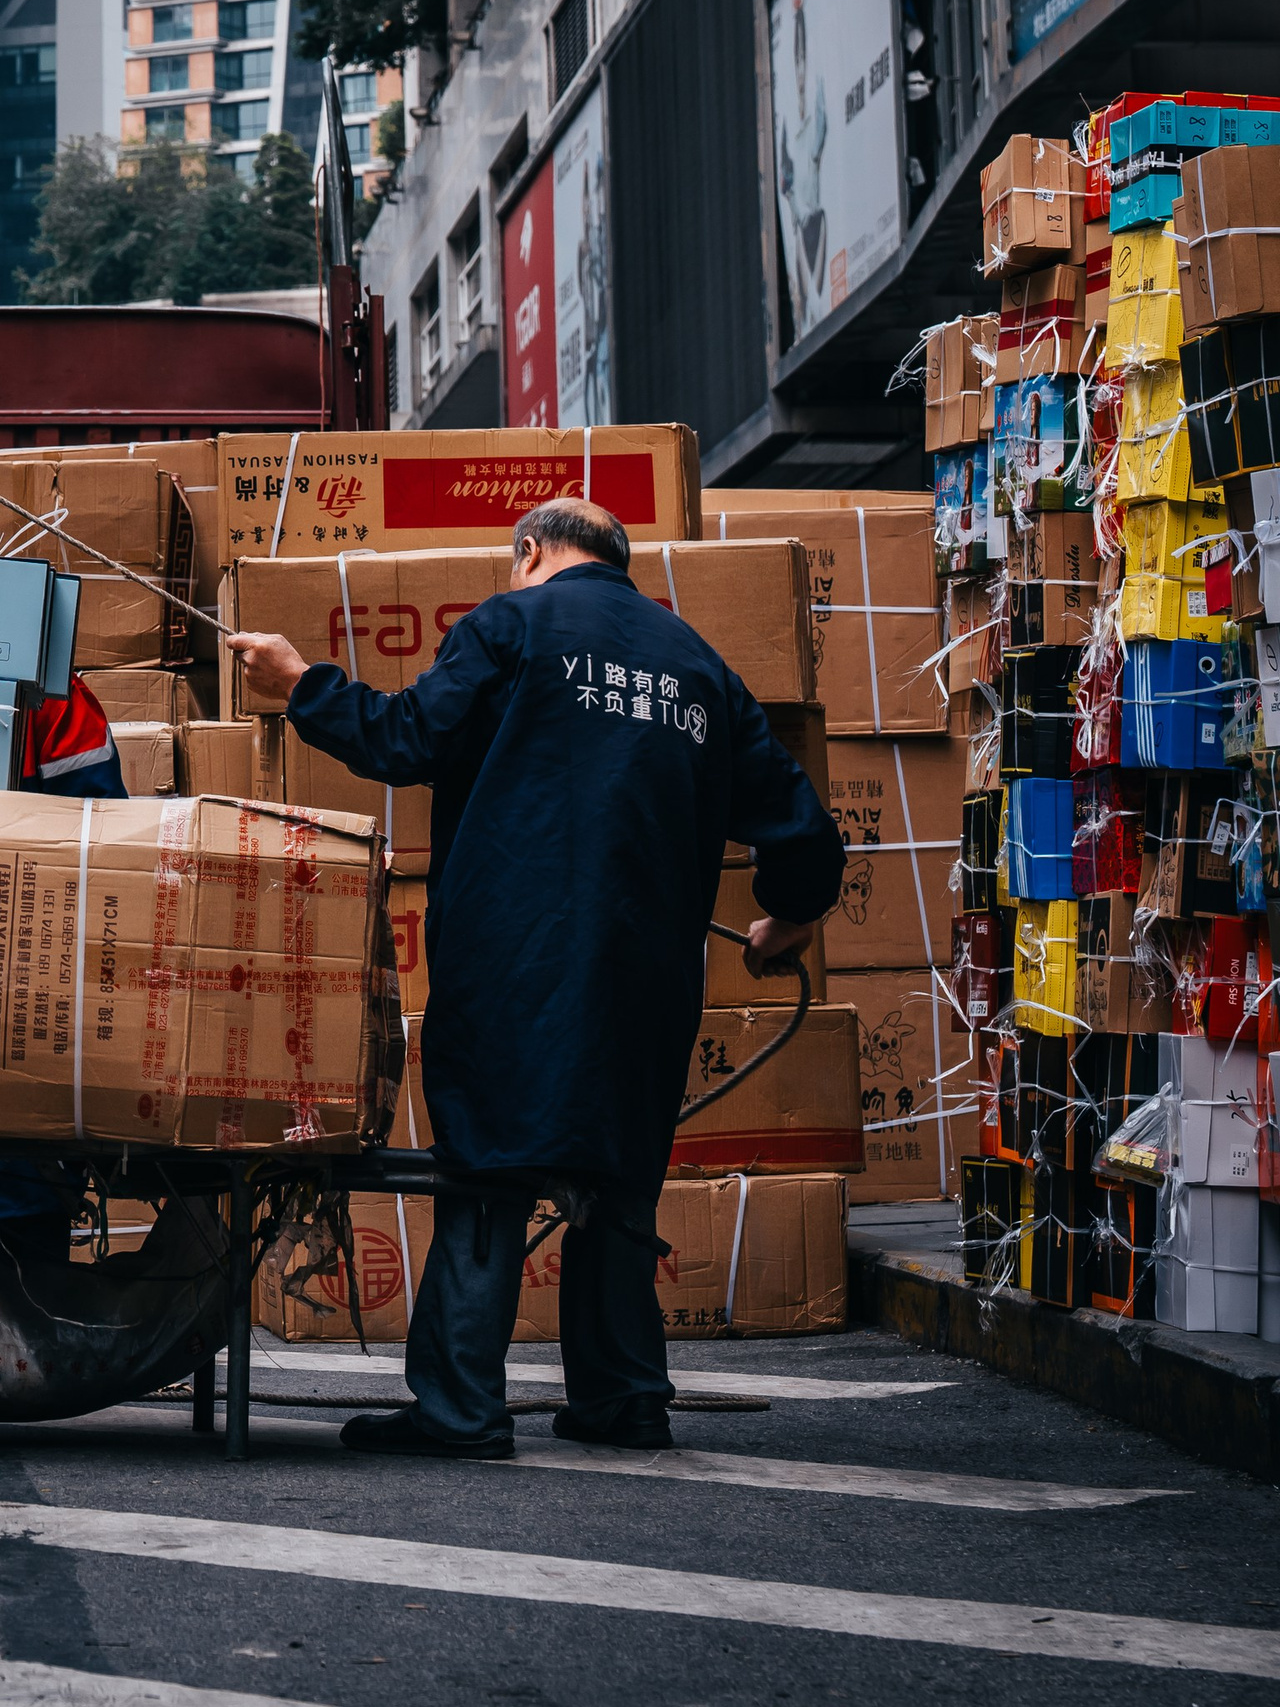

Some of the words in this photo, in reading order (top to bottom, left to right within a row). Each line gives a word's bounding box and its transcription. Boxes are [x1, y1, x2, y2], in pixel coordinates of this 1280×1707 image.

[227, 455, 290, 469] ASUAL
[303, 453, 378, 467] FASHION
[235, 474, 286, 502] 时尚
[604, 662, 679, 699] 路有你
[1228, 957, 1240, 1006] FASION
[866, 1141, 922, 1162] 雪地鞋
